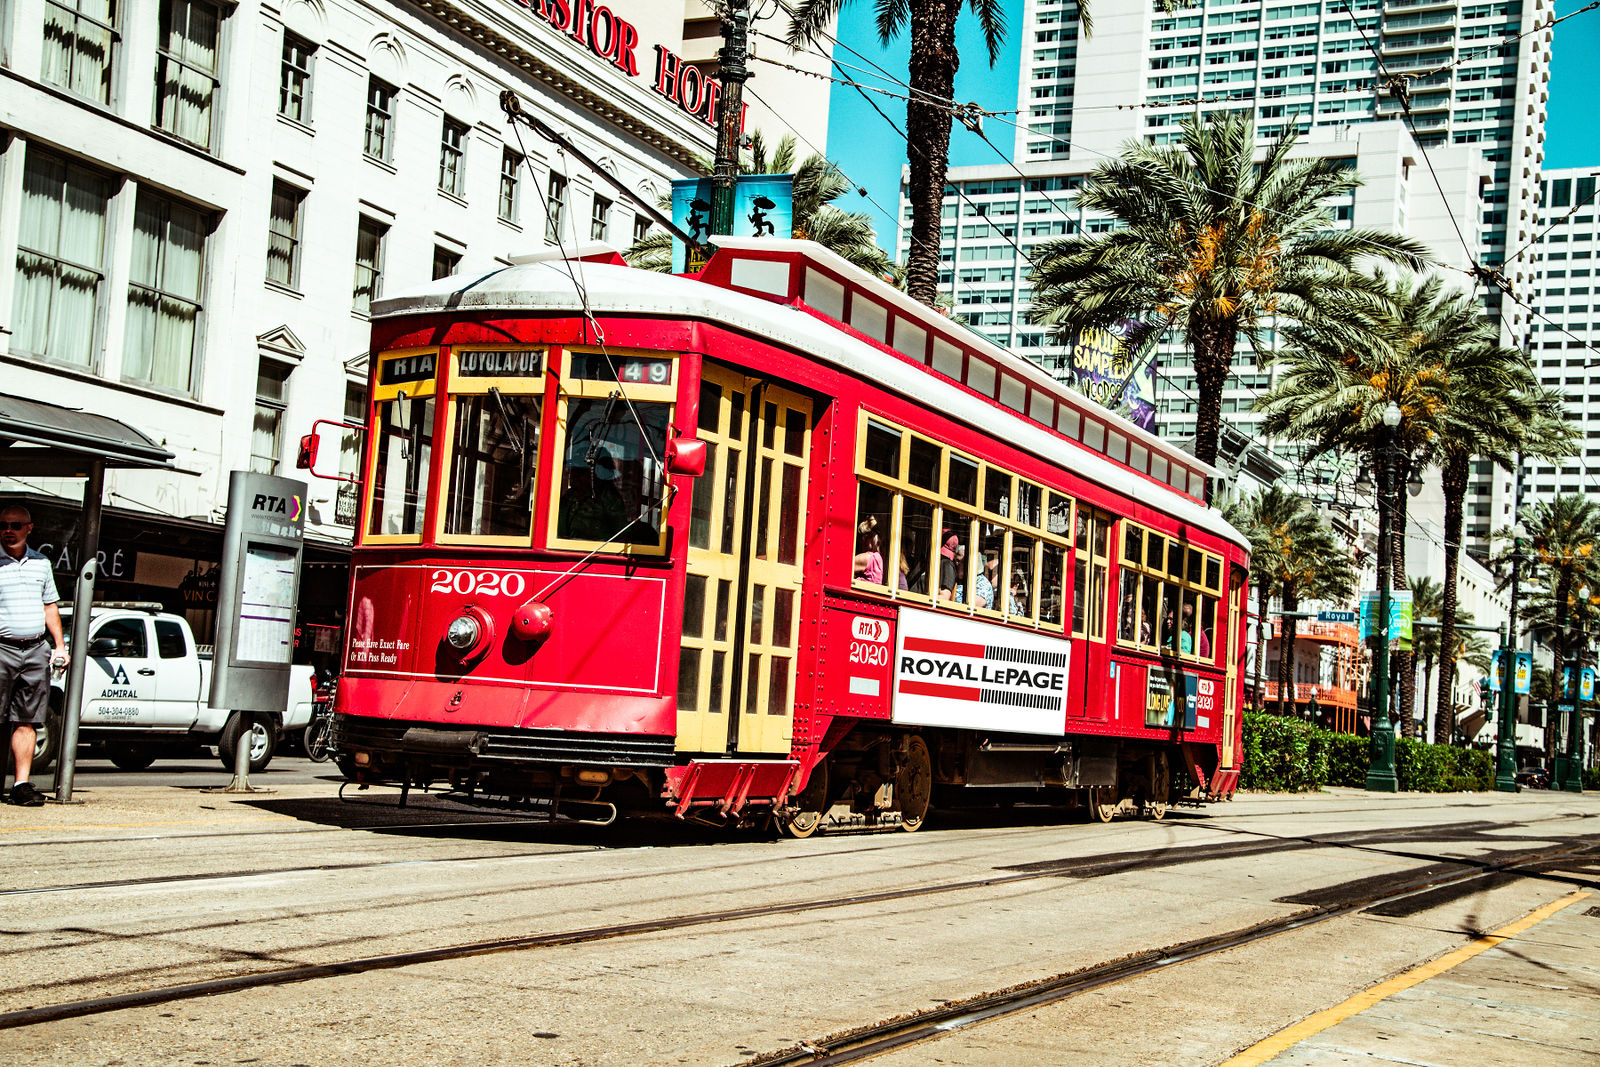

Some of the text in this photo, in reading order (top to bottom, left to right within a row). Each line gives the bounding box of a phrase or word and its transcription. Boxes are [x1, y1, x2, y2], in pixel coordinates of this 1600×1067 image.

[654, 44, 752, 149] HOTL
[624, 362, 668, 384] 49
[252, 493, 286, 514] RTA
[37, 543, 125, 577] CARÉ
[430, 569, 526, 597] 2020
[1325, 611, 1349, 622] Royal
[858, 622, 873, 637] RTA
[352, 637, 410, 650] Please Have Exact Fare
[850, 641, 888, 667] 2020
[350, 651, 397, 665] Or RTA Pass Ready
[900, 656, 979, 682] ROYAL
[101, 689, 138, 698] ADMIRAL
[1197, 695, 1214, 711] 2020
